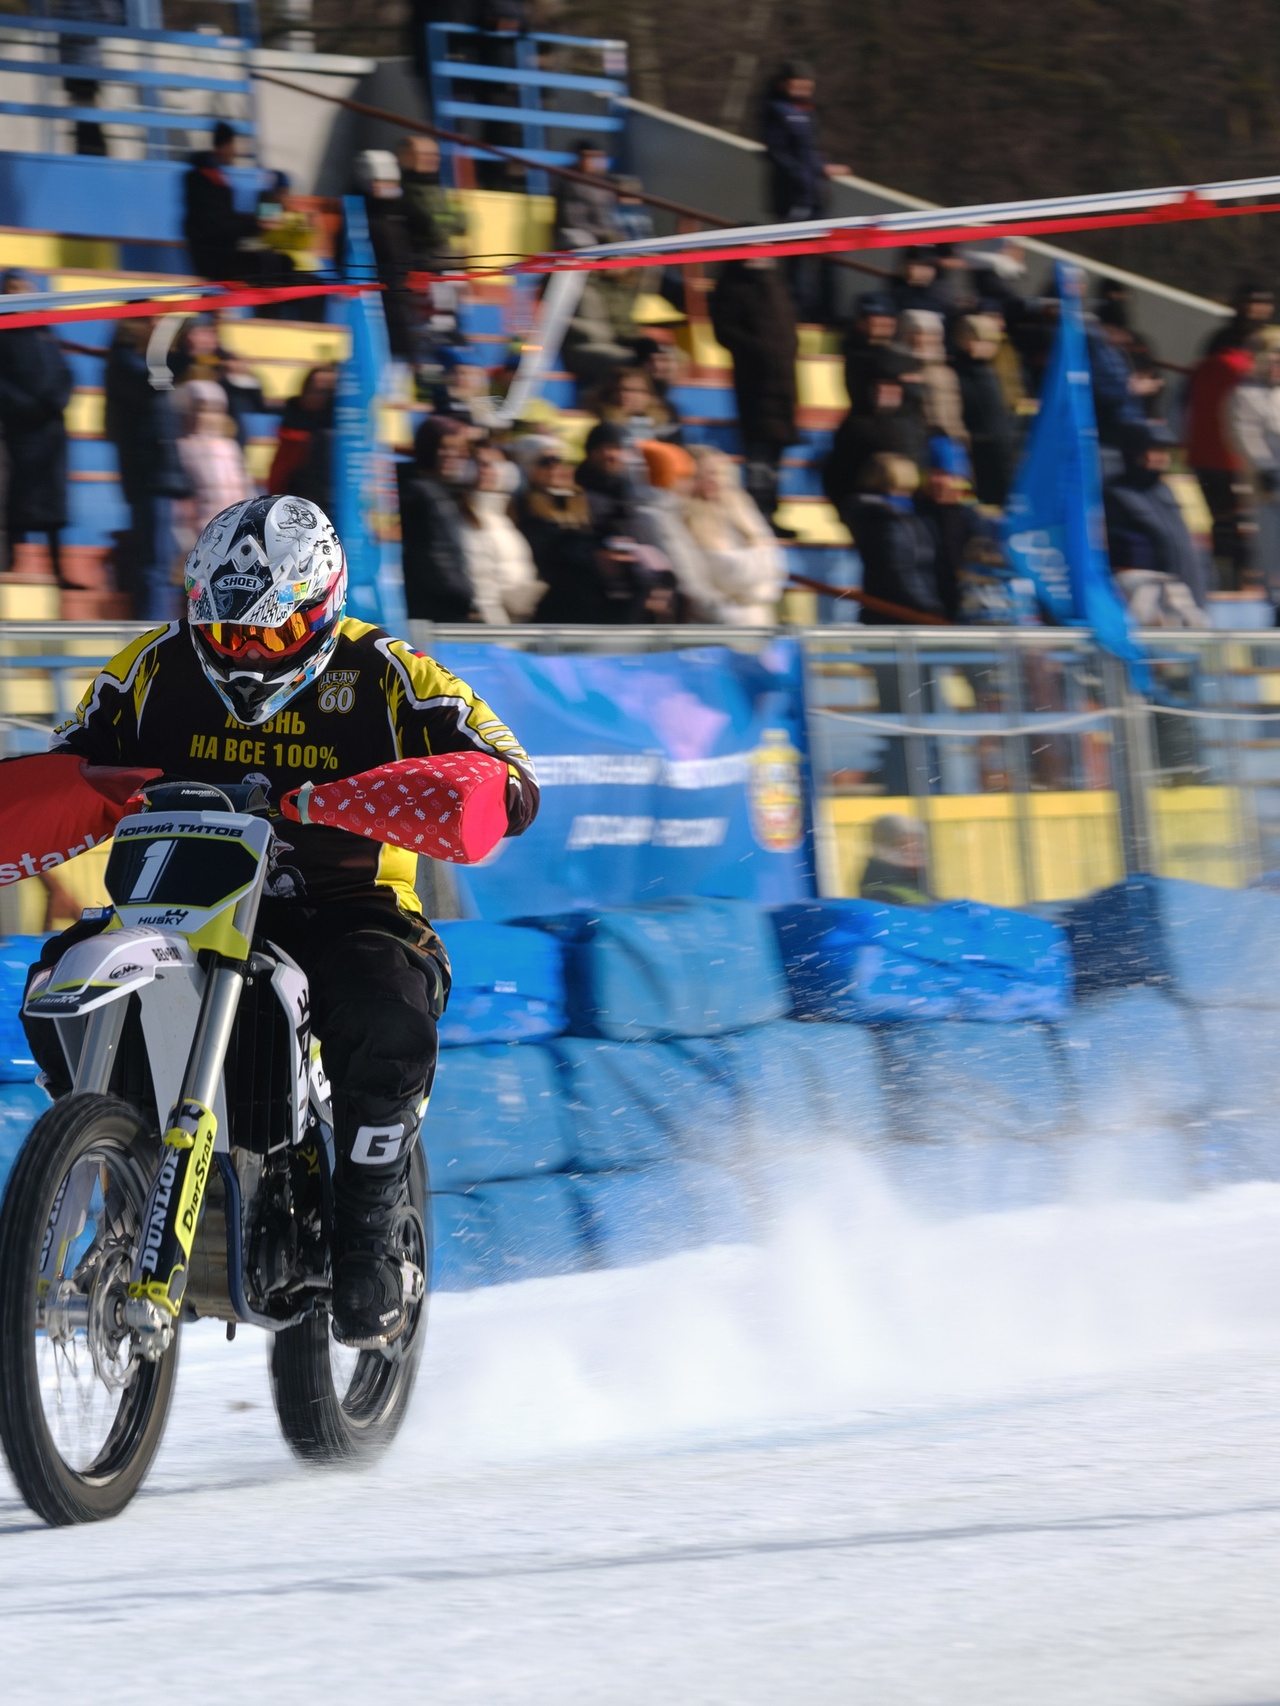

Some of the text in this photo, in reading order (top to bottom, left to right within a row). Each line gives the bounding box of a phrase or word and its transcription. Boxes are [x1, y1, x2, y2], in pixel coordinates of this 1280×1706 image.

[222, 577, 257, 588] SHOEI
[320, 672, 357, 688] ДЕДУ
[320, 686, 353, 711] 60
[224, 711, 306, 735] ЖЗНЬ
[189, 734, 338, 770] НА ВСЕ 100%
[118, 823, 244, 838] ЮРИЙ ТИТОВ
[128, 839, 177, 902] 1
[137, 916, 184, 925] HUSKY
[141, 1148, 180, 1274] DUNLOP
